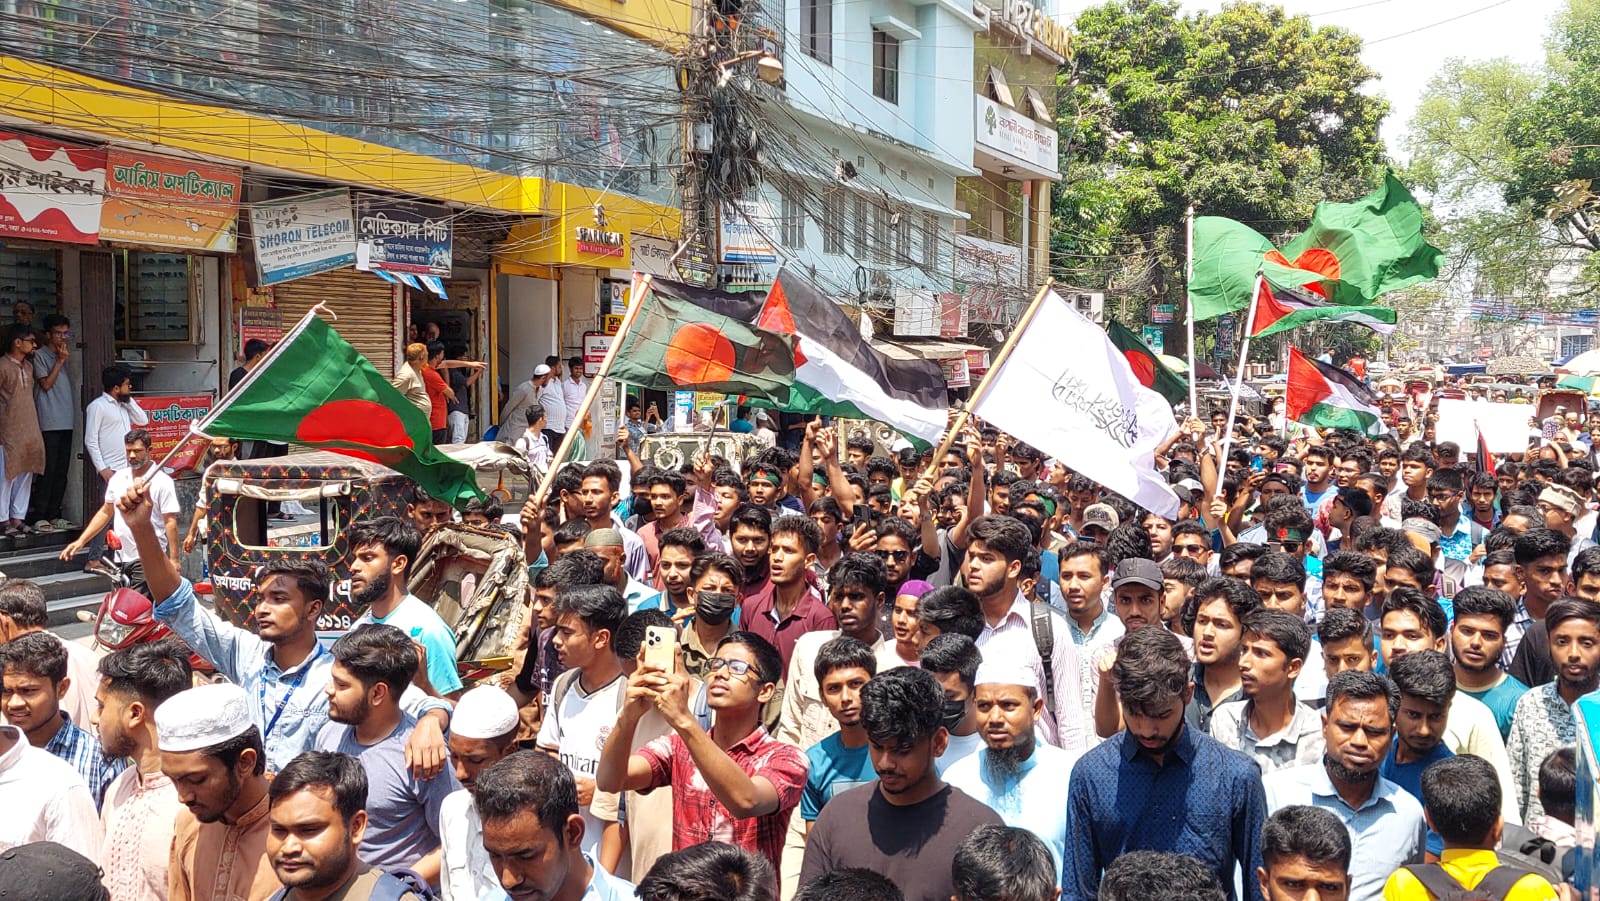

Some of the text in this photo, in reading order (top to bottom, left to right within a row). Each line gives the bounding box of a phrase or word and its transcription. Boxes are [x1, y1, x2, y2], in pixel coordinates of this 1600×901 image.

[113, 162, 236, 202] আনিস অপটিক্যাল
[259, 229, 302, 249] SHORON
[306, 219, 350, 240] TELECOM
[360, 211, 420, 241] মেডিক্যাল
[559, 751, 599, 775] mirat
